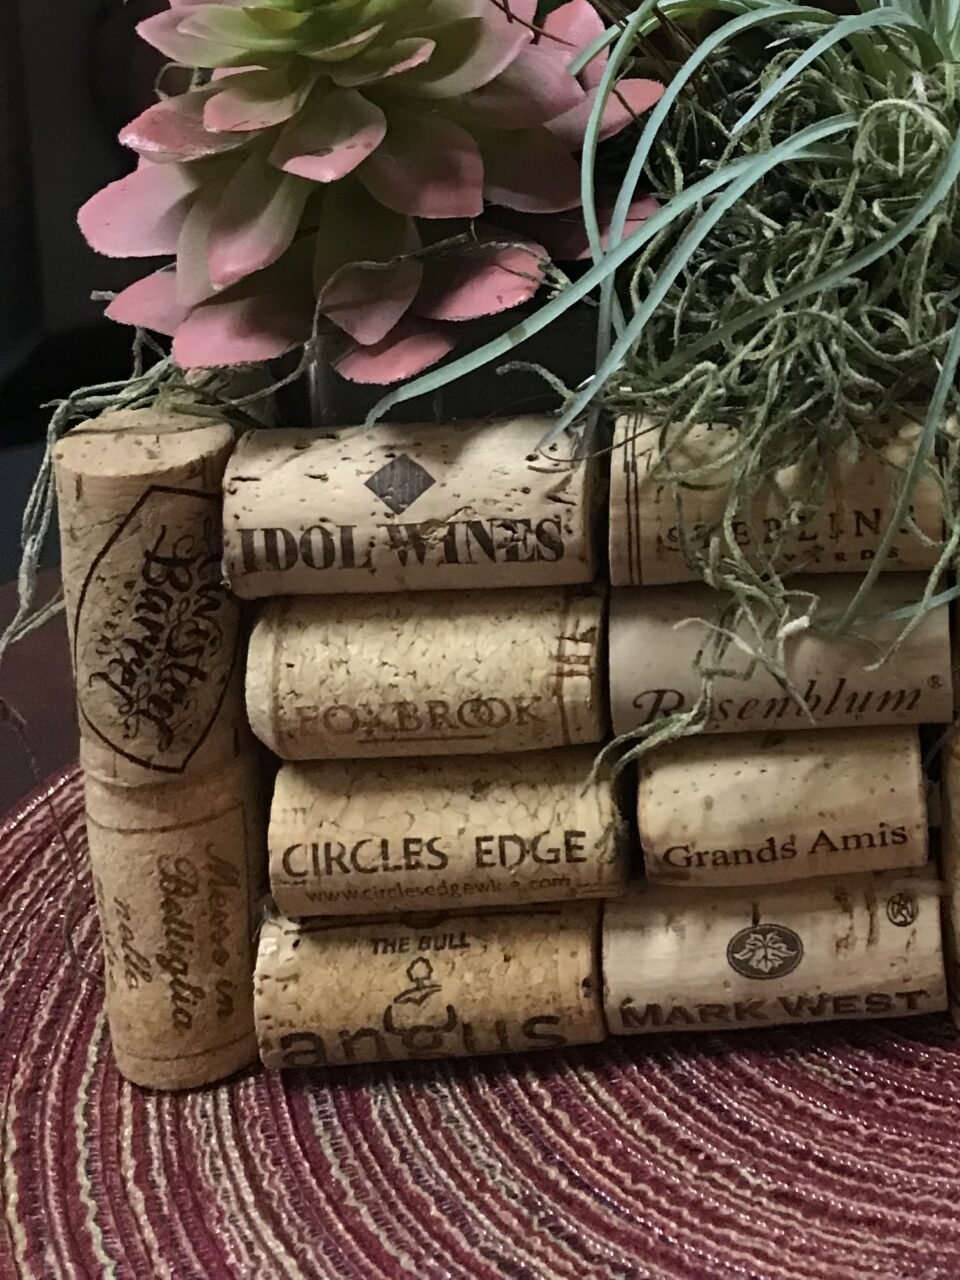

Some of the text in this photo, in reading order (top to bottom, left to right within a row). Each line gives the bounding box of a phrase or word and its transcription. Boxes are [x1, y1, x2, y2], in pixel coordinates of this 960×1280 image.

[236, 517, 566, 575] IDOL WINES
[295, 695, 544, 736] FOXBROOK
[282, 830, 588, 878] CIRCLES EDGE
[662, 821, 908, 868] Grands Amis
[371, 931, 471, 956] THE BULL
[618, 988, 929, 1028] MARK WEST
